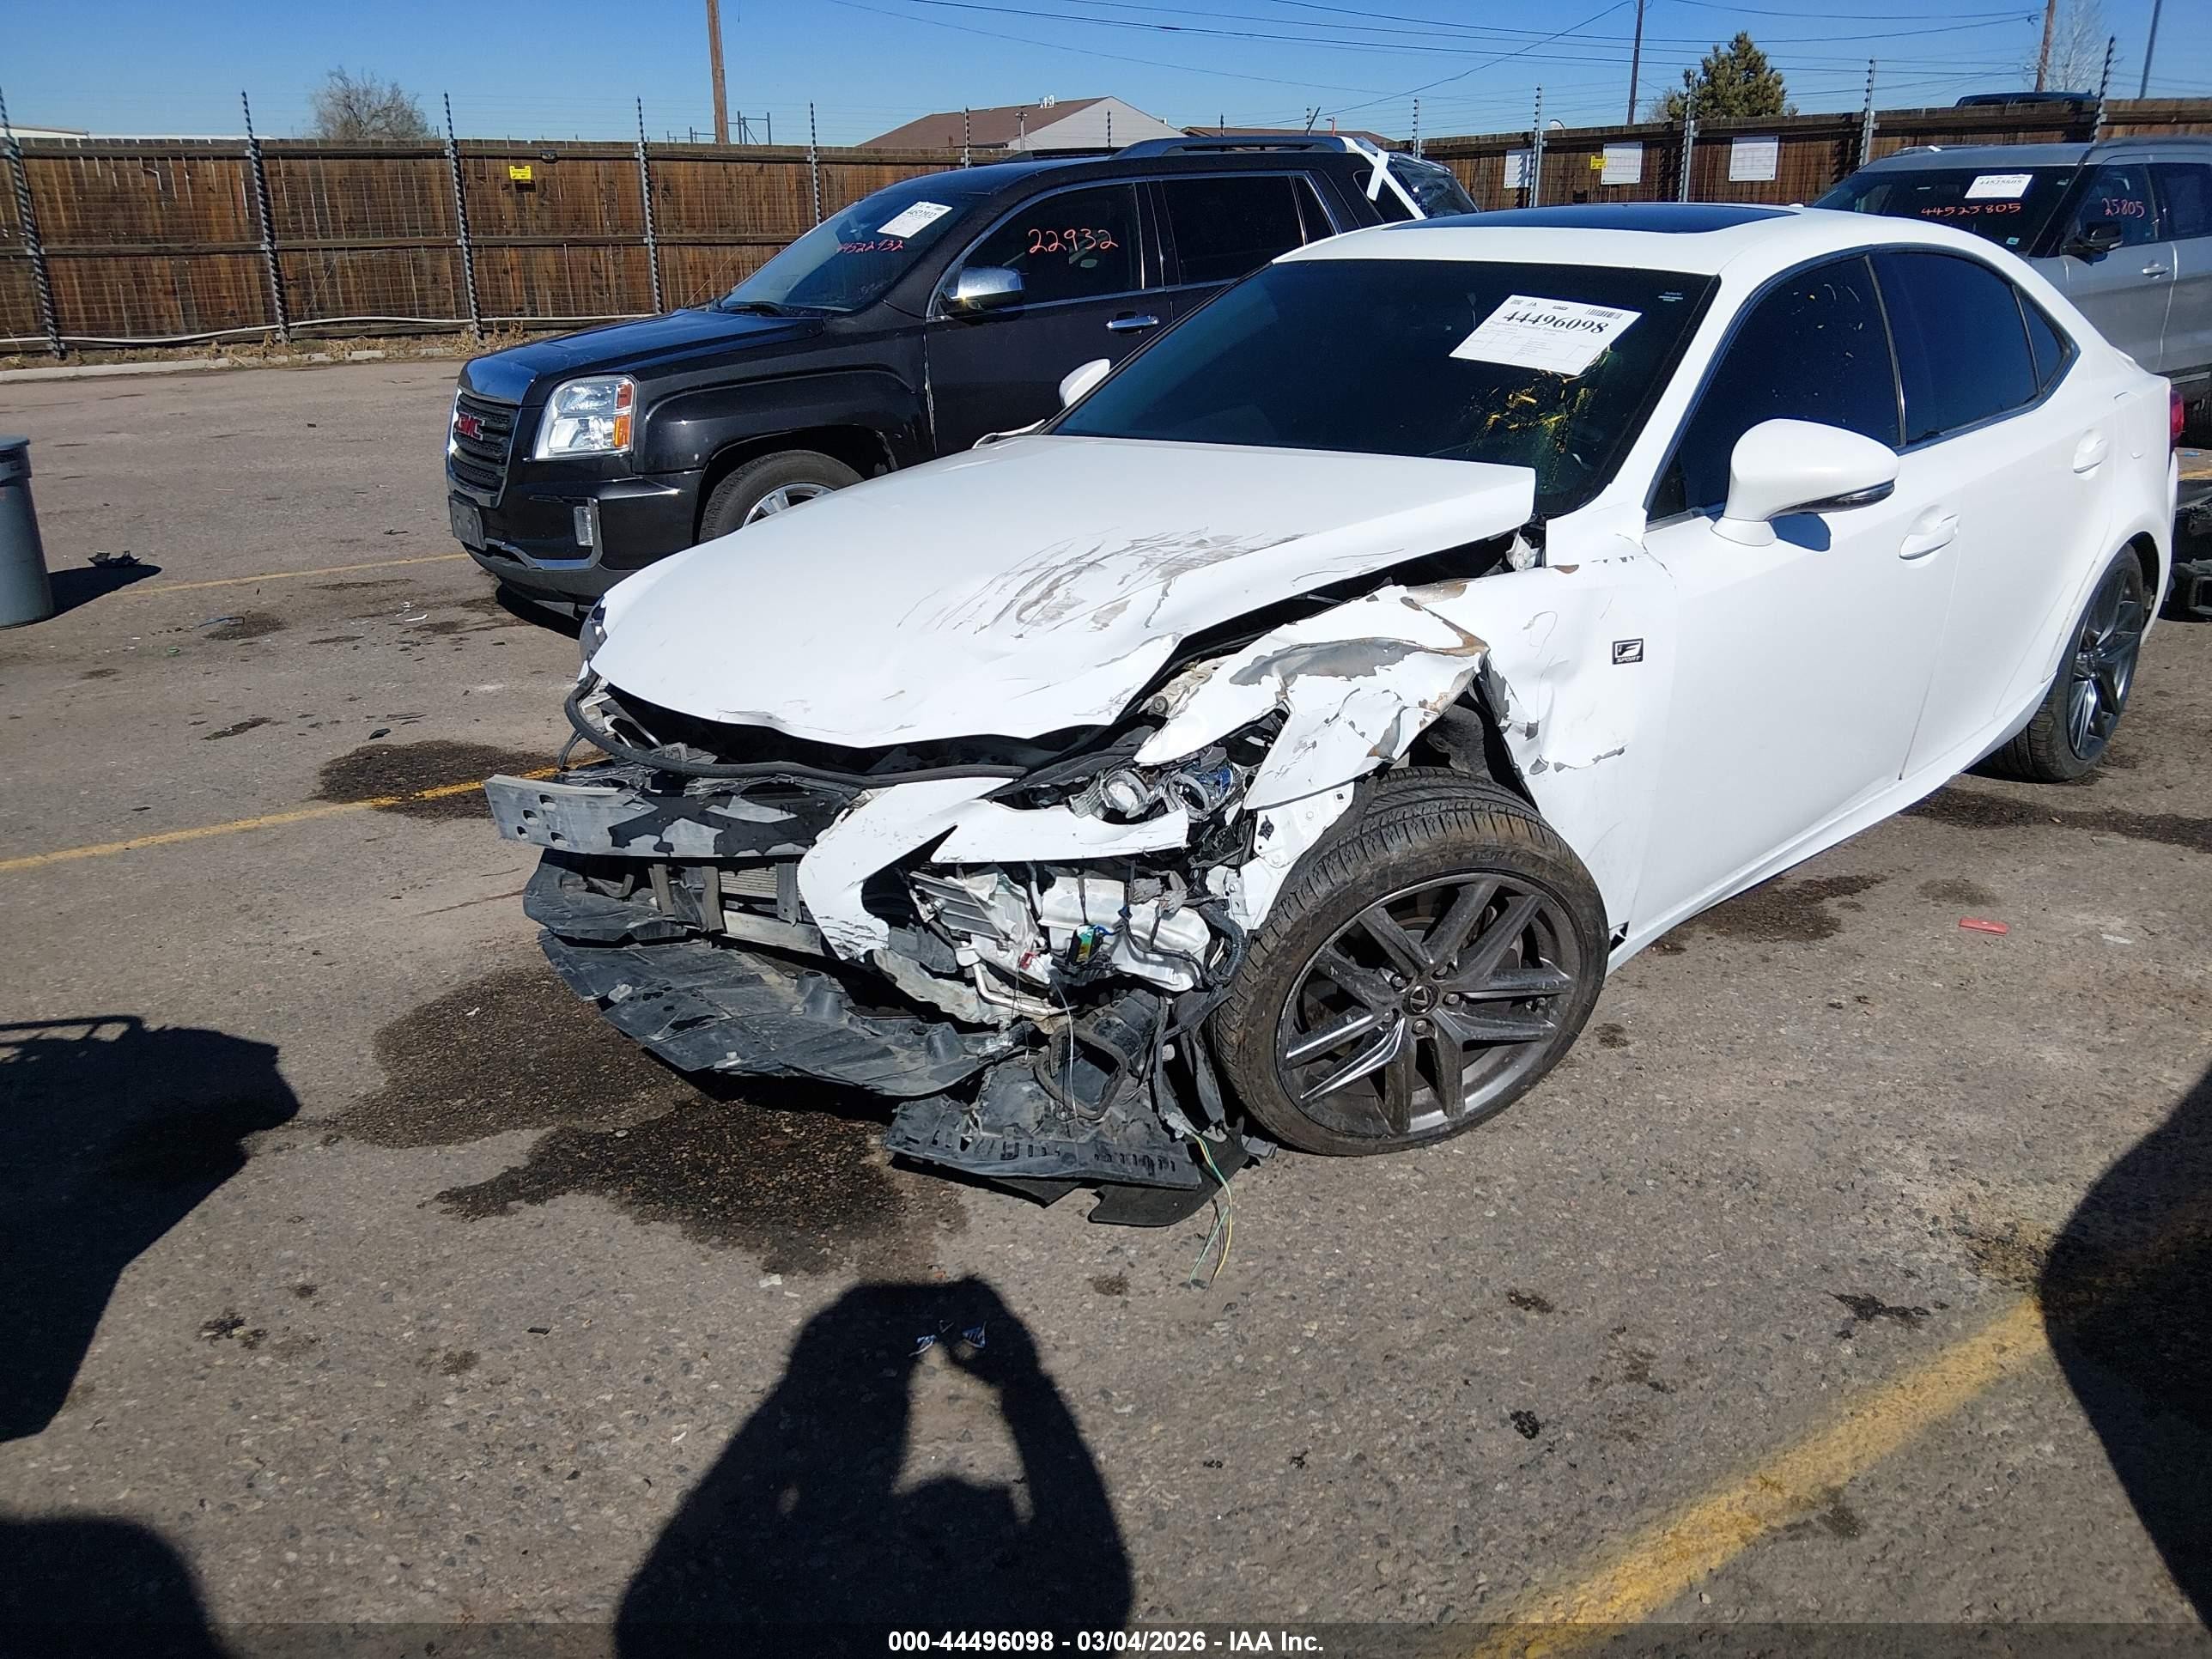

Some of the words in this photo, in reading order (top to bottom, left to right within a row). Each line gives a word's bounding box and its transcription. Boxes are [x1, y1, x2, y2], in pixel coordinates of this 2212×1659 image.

[2101, 198, 2145, 218] 25805
[1028, 228, 1119, 253] 22932
[1502, 310, 1609, 334] 44496098
[455, 411, 485, 441] GMC
